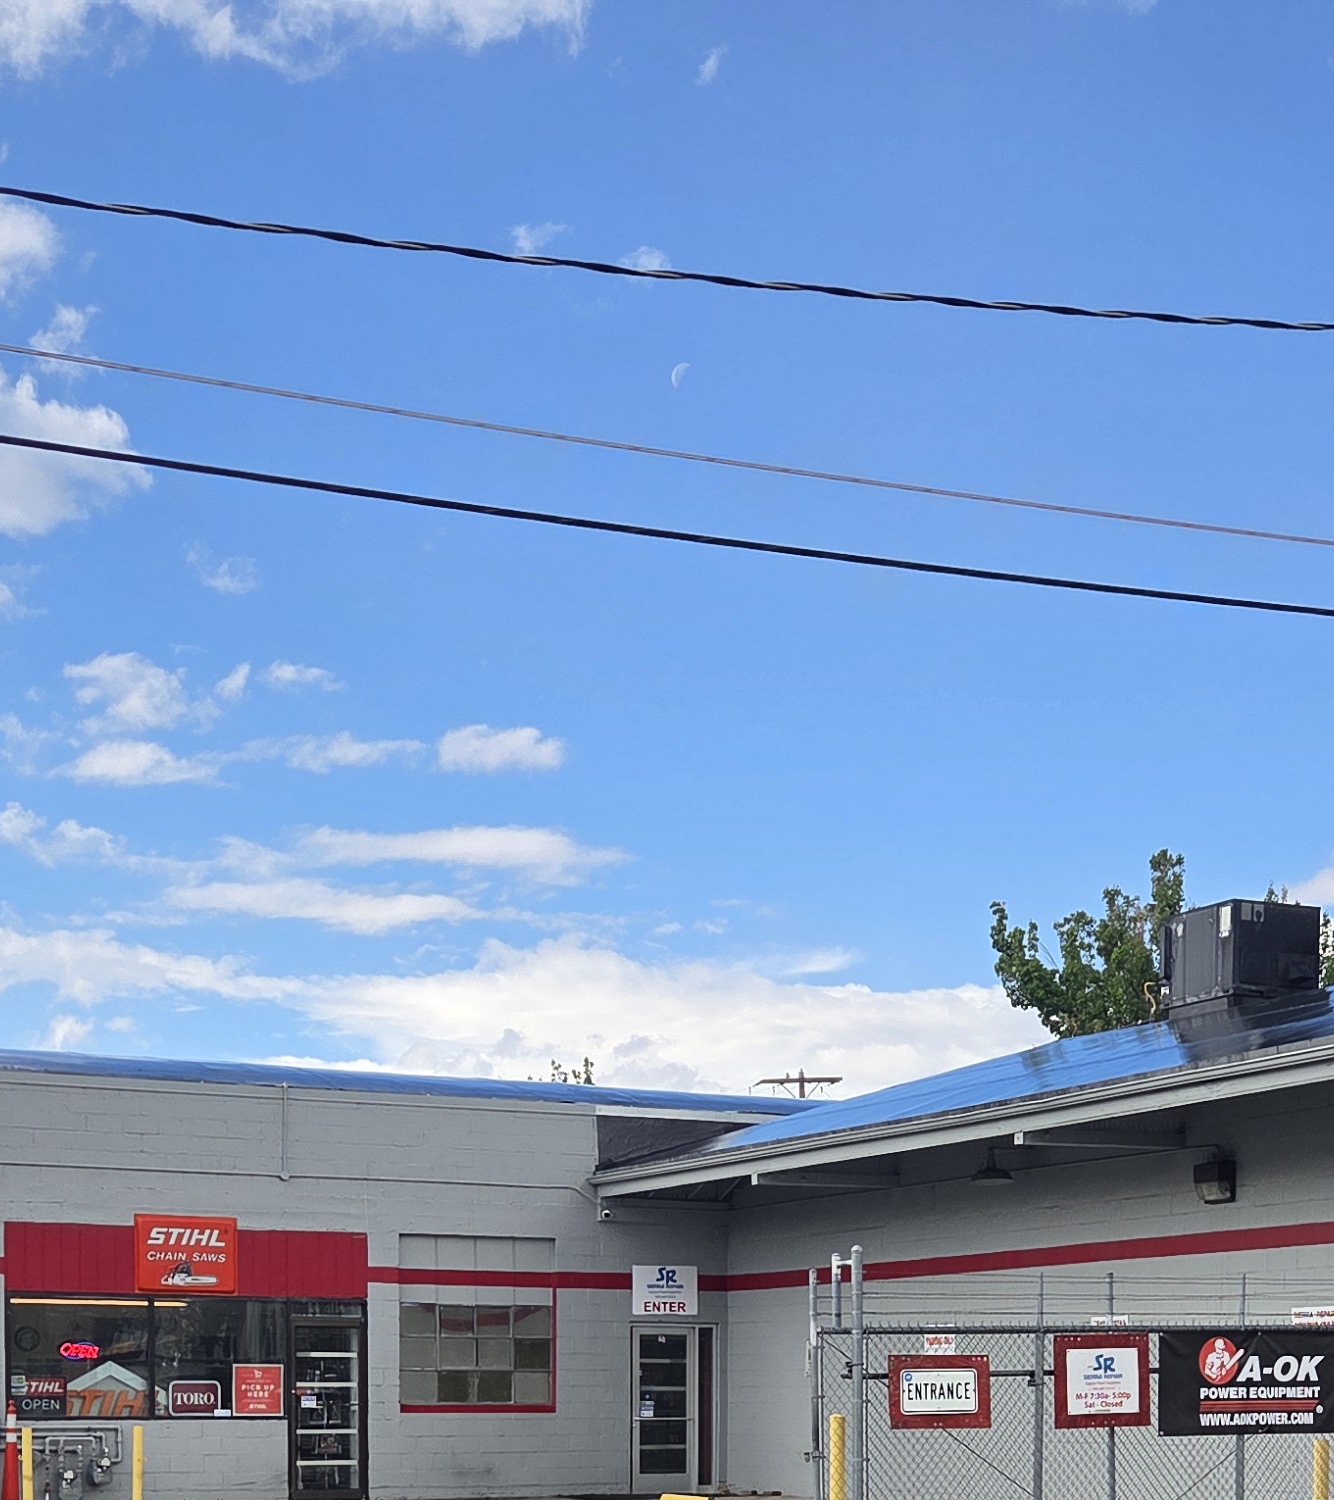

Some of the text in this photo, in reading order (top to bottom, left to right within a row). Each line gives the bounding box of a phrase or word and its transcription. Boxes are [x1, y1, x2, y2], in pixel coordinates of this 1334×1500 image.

[147, 1227, 226, 1247] STIHL
[147, 1250, 227, 1263] CHAIN SAWS
[644, 1301, 687, 1313] ENTER
[60, 1342, 99, 1359] OPEN
[1093, 1353, 1116, 1374] SR
[1236, 1355, 1324, 1382] A-OK
[907, 1382, 971, 1401] ENTRANCE
[1075, 1392, 1089, 1400] M-F
[1112, 1391, 1131, 1400] 5:00p
[1199, 1386, 1321, 1399] POWER EQUIPMENT
[22, 1398, 61, 1411] OPEN
[173, 1392, 215, 1406] TORO
[1100, 1400, 1123, 1408] Closed
[1199, 1412, 1314, 1426] WWW.AOKPOWER.COM
